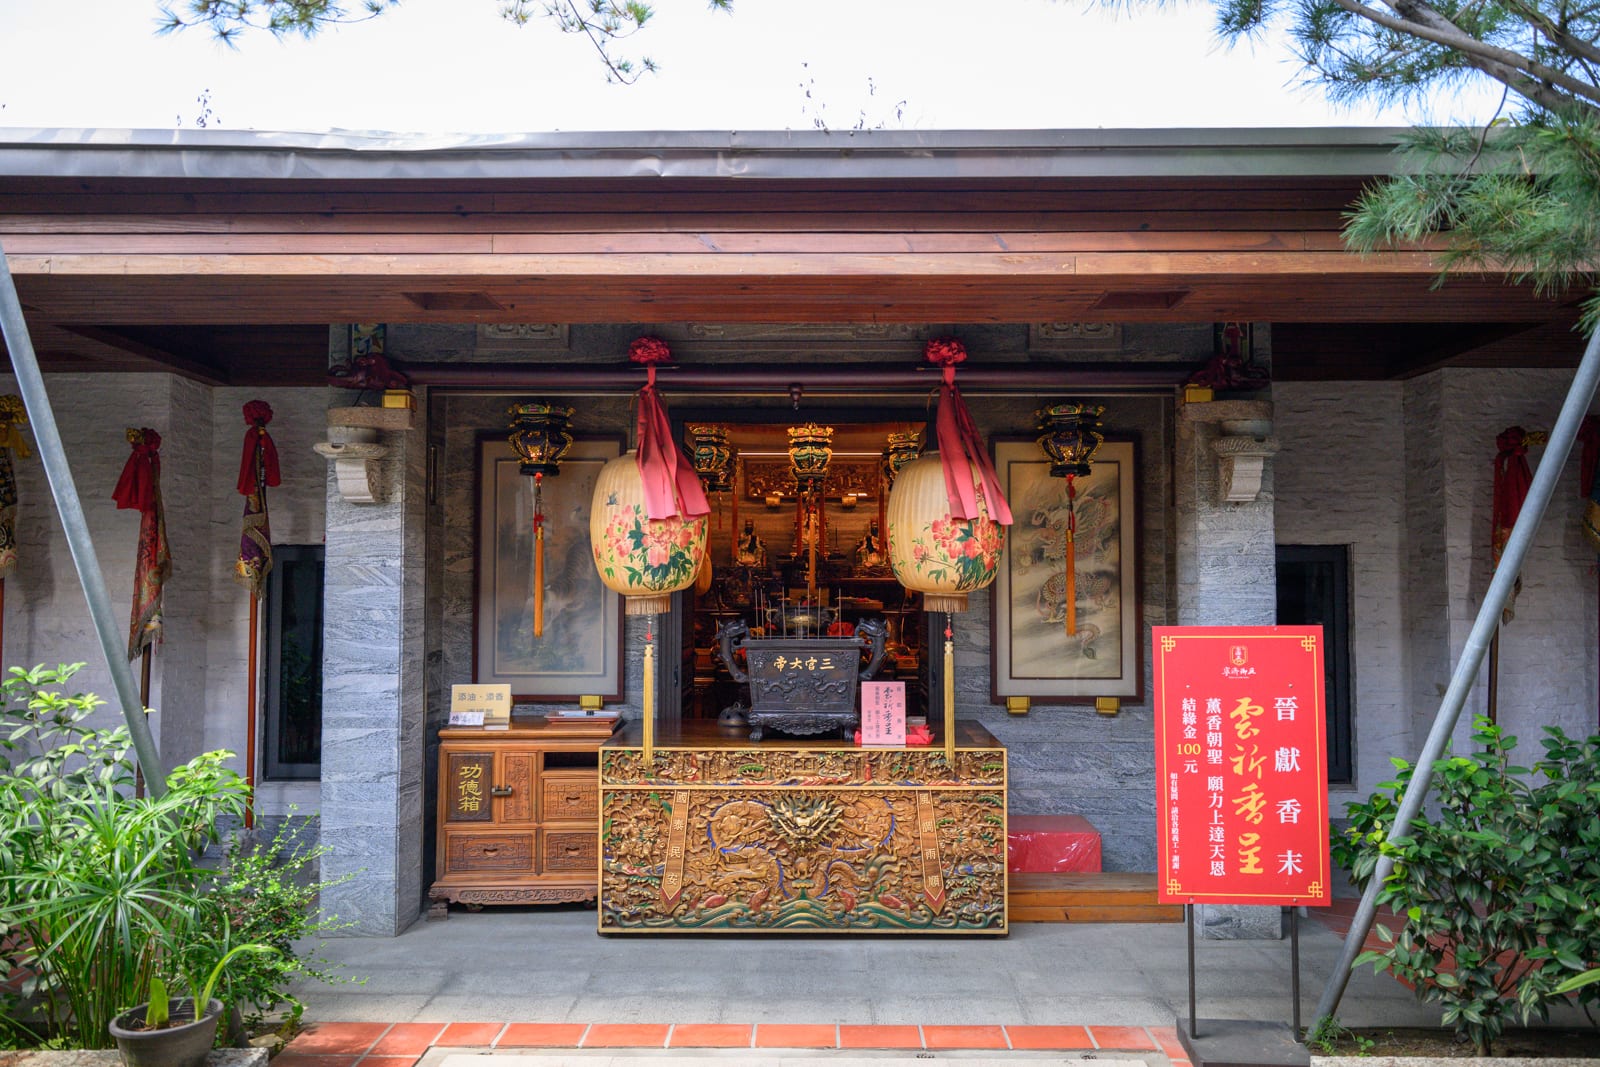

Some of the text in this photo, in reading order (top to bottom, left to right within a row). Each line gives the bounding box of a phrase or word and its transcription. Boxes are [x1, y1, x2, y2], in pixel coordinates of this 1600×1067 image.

[773, 655, 835, 672] 三官大帝
[1177, 697, 1201, 774] 結緣金 100 元
[458, 763, 483, 812] 功德箱
[1207, 775, 1226, 877] 願力上達天恩
[1229, 697, 1268, 875] 雲祈香呈
[1273, 696, 1304, 876] 晉獻香末
[667, 791, 688, 886] 國泰民安
[919, 793, 940, 888] 風調雨順
